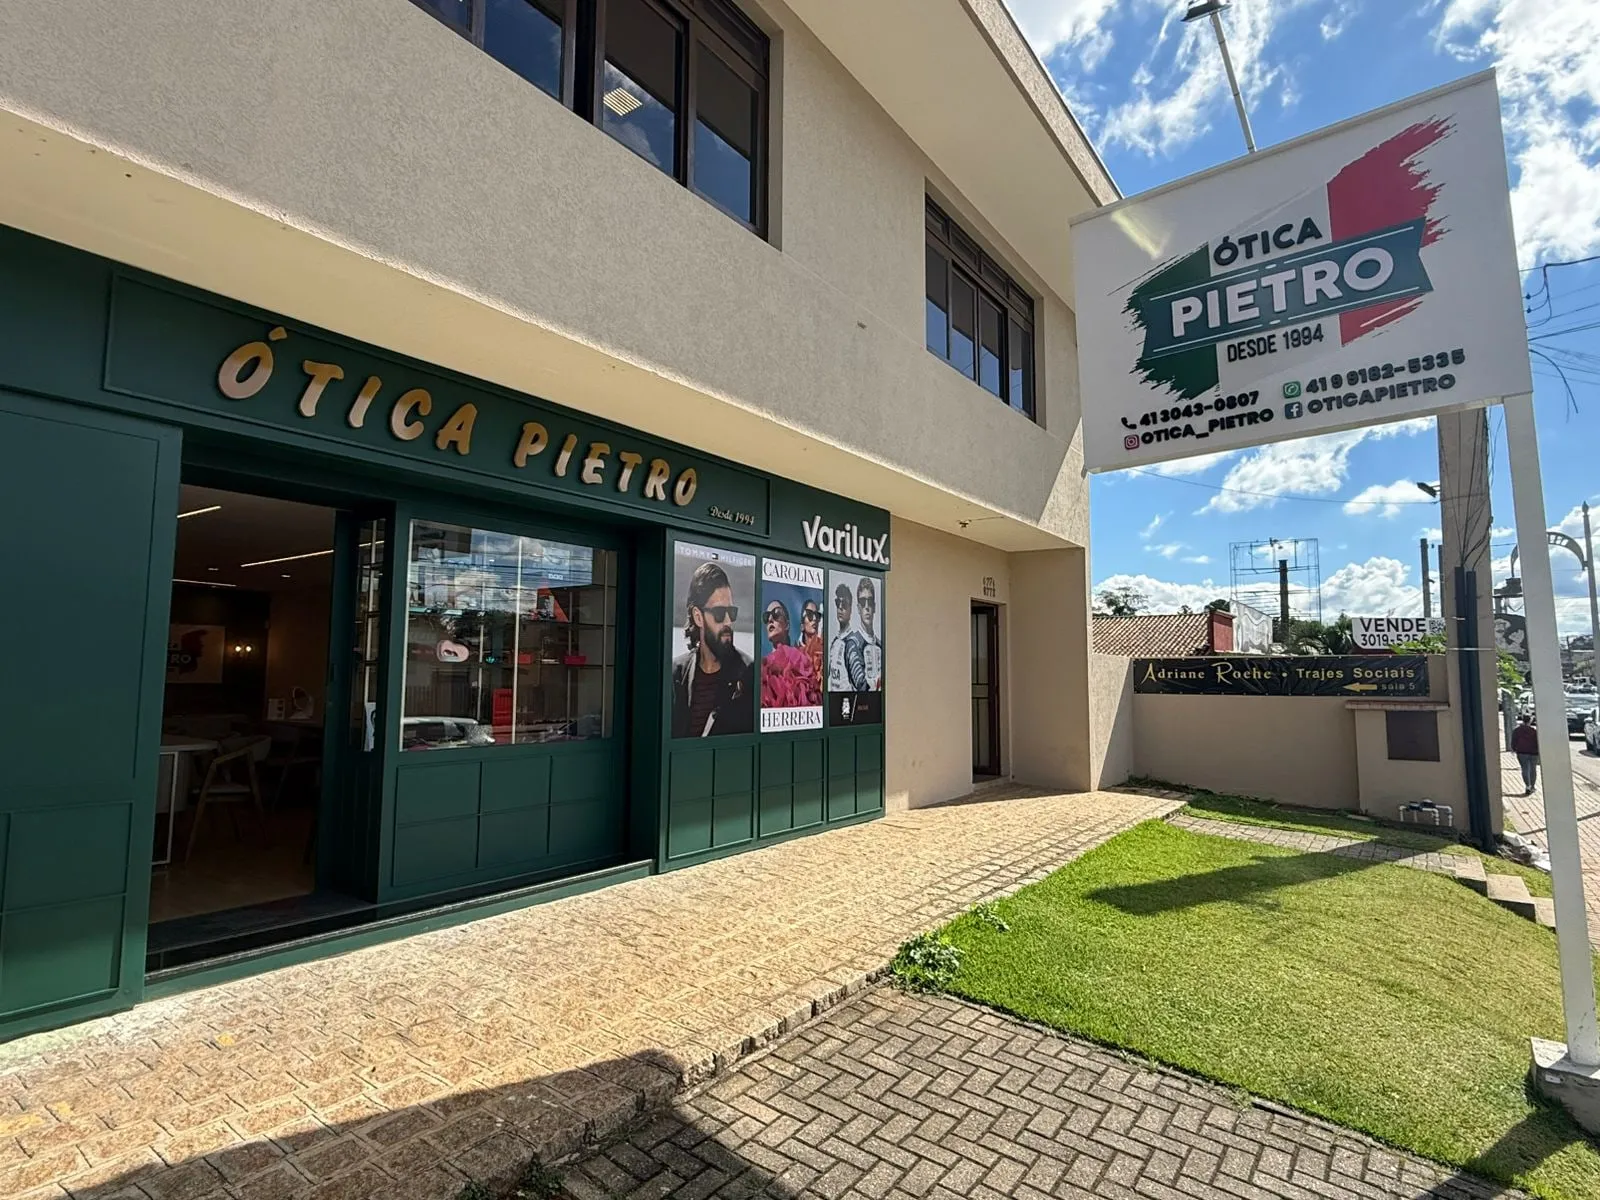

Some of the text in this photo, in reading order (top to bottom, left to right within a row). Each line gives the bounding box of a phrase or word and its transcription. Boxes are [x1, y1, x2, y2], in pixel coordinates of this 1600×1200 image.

[1213, 216, 1323, 267] ÓTICA
[1171, 247, 1394, 338] PIETRO
[1227, 323, 1324, 362] DESDE 1994
[1307, 373, 1456, 414] OTICAPIETRO
[217, 326, 699, 507] ÓTICA PIETRO
[1141, 408, 1274, 445] OTICA_PIETRO
[710, 505, 755, 526] Desde 1994
[763, 561, 822, 585] CAROLINA
[1360, 618, 1427, 632] VENDE
[1140, 662, 1205, 685] Adriane
[1296, 668, 1344, 681] Trajes
[1353, 667, 1415, 679] Sociais
[1409, 682, 1416, 691] 5
[761, 710, 821, 728] HERRERA
